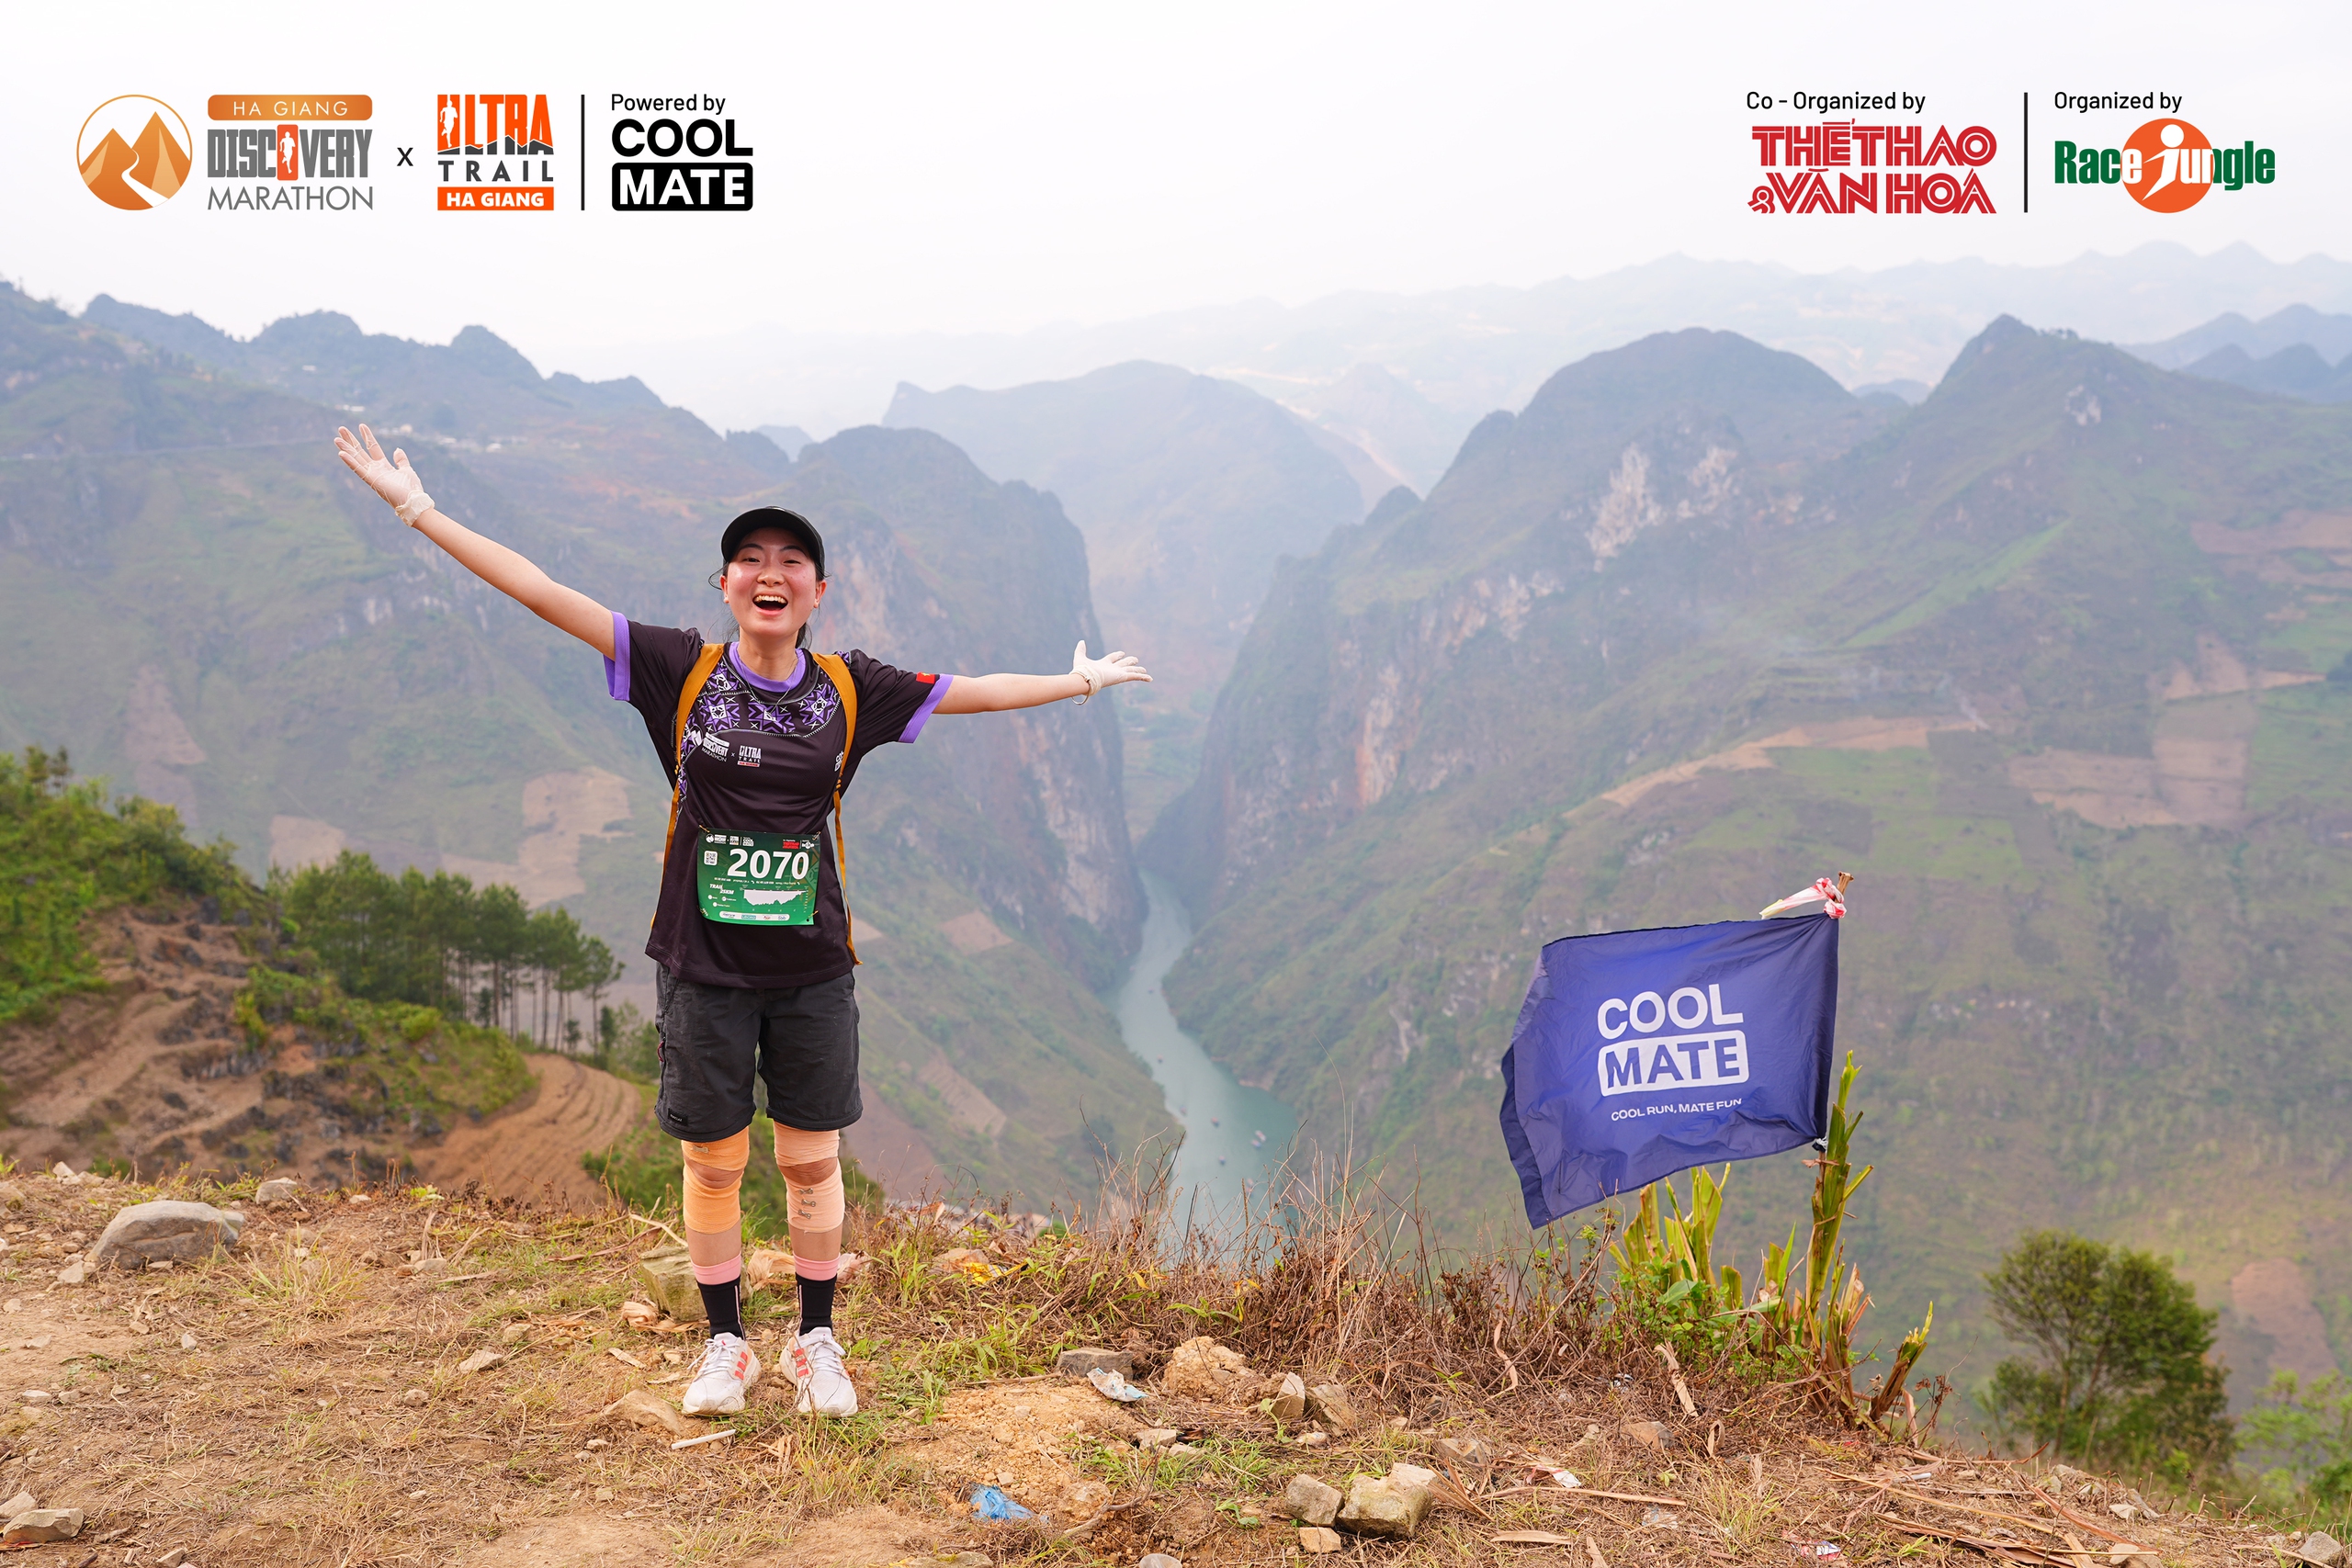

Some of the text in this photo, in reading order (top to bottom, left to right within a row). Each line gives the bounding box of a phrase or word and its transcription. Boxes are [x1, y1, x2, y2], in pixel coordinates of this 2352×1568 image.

[701, 747, 727, 762] MARATHON
[739, 745, 762, 759] ULTRA
[739, 756, 761, 764] TRAIL
[727, 848, 809, 880] 2070
[1597, 984, 1744, 1040] COOL
[1606, 1038, 1740, 1089] MATE
[1611, 1098, 1742, 1122] COOL RUN, MATE FUN
